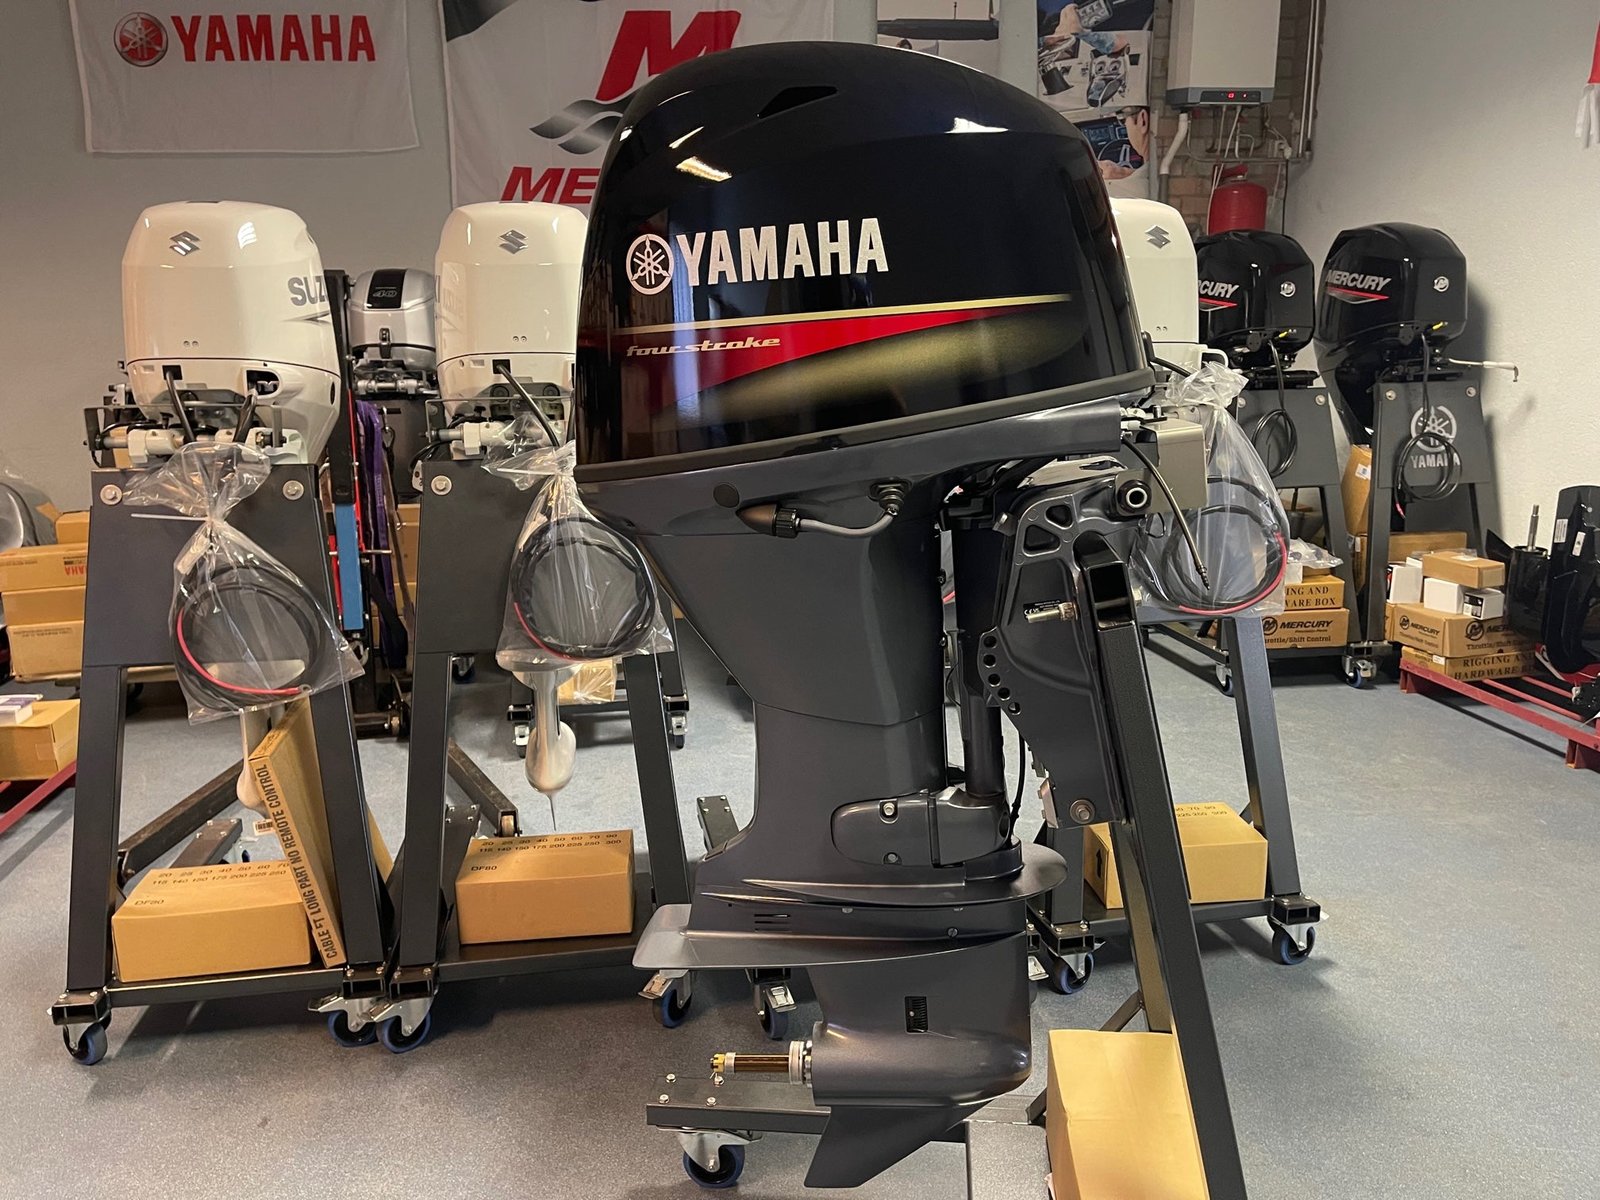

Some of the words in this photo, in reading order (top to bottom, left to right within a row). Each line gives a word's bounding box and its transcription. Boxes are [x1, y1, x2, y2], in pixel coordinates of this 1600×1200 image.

[171, 14, 377, 63] YAMAHA
[676, 217, 889, 287] YAMAHA
[1326, 269, 1392, 291] MERCURY
[627, 345, 683, 357] four
[685, 336, 781, 352] stroke
[1308, 586, 1329, 595] AND
[1315, 597, 1336, 606] BOX
[1280, 620, 1333, 629] MERCURY
[1410, 622, 1440, 636] MERCURY
[1463, 655, 1510, 668] RIGGING
[1454, 666, 1516, 680] HARDWARE
[256, 763, 281, 808] CONTROL
[274, 809, 297, 852] REMOTE
[287, 851, 303, 865] NO
[293, 864, 314, 890] PART
[302, 888, 323, 918] LONG
[313, 916, 326, 931] FT
[318, 929, 337, 959] CABLE
